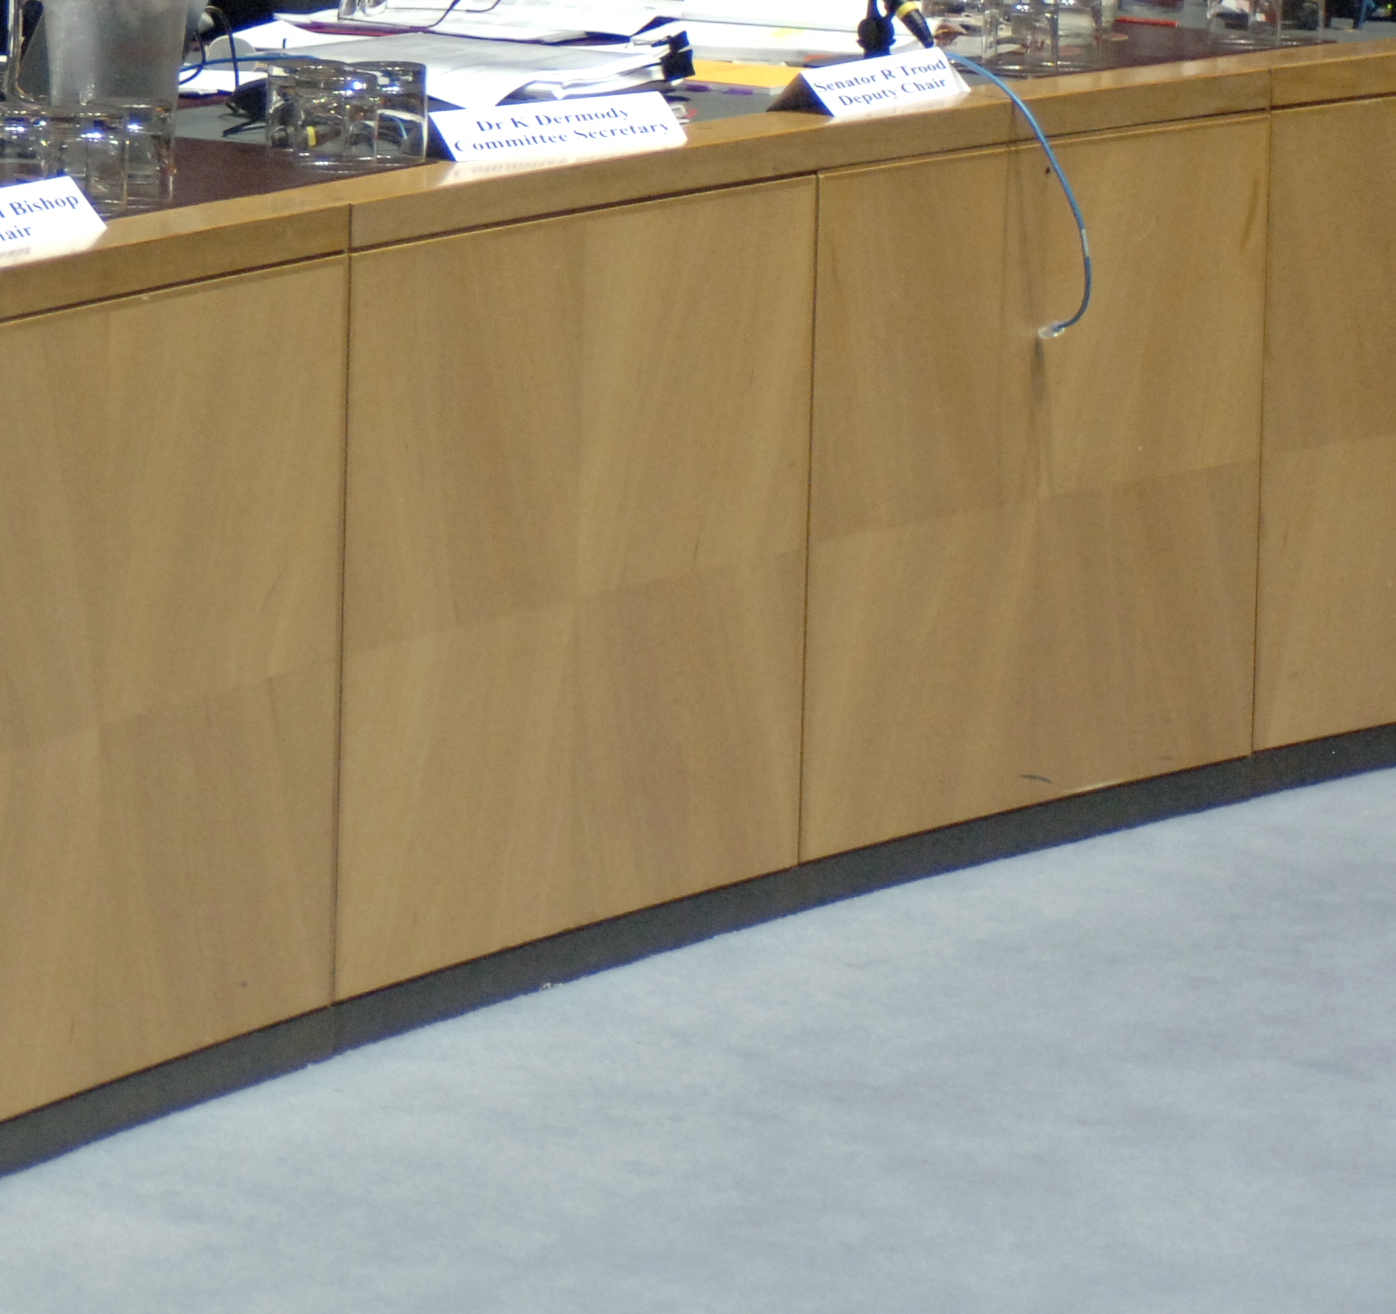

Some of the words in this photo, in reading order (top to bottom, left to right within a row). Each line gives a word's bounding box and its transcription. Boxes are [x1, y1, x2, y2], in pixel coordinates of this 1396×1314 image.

[814, 72, 877, 93] Senator
[881, 69, 896, 81] R
[898, 59, 947, 78] Trood
[838, 88, 898, 106] Deputy
[901, 77, 947, 94] Chair
[475, 119, 504, 132] Dr
[510, 116, 529, 128] K
[535, 107, 629, 126] Dermody
[454, 131, 569, 152] Committee
[573, 122, 670, 141] Secretary
[8, 194, 79, 216] Bishop
